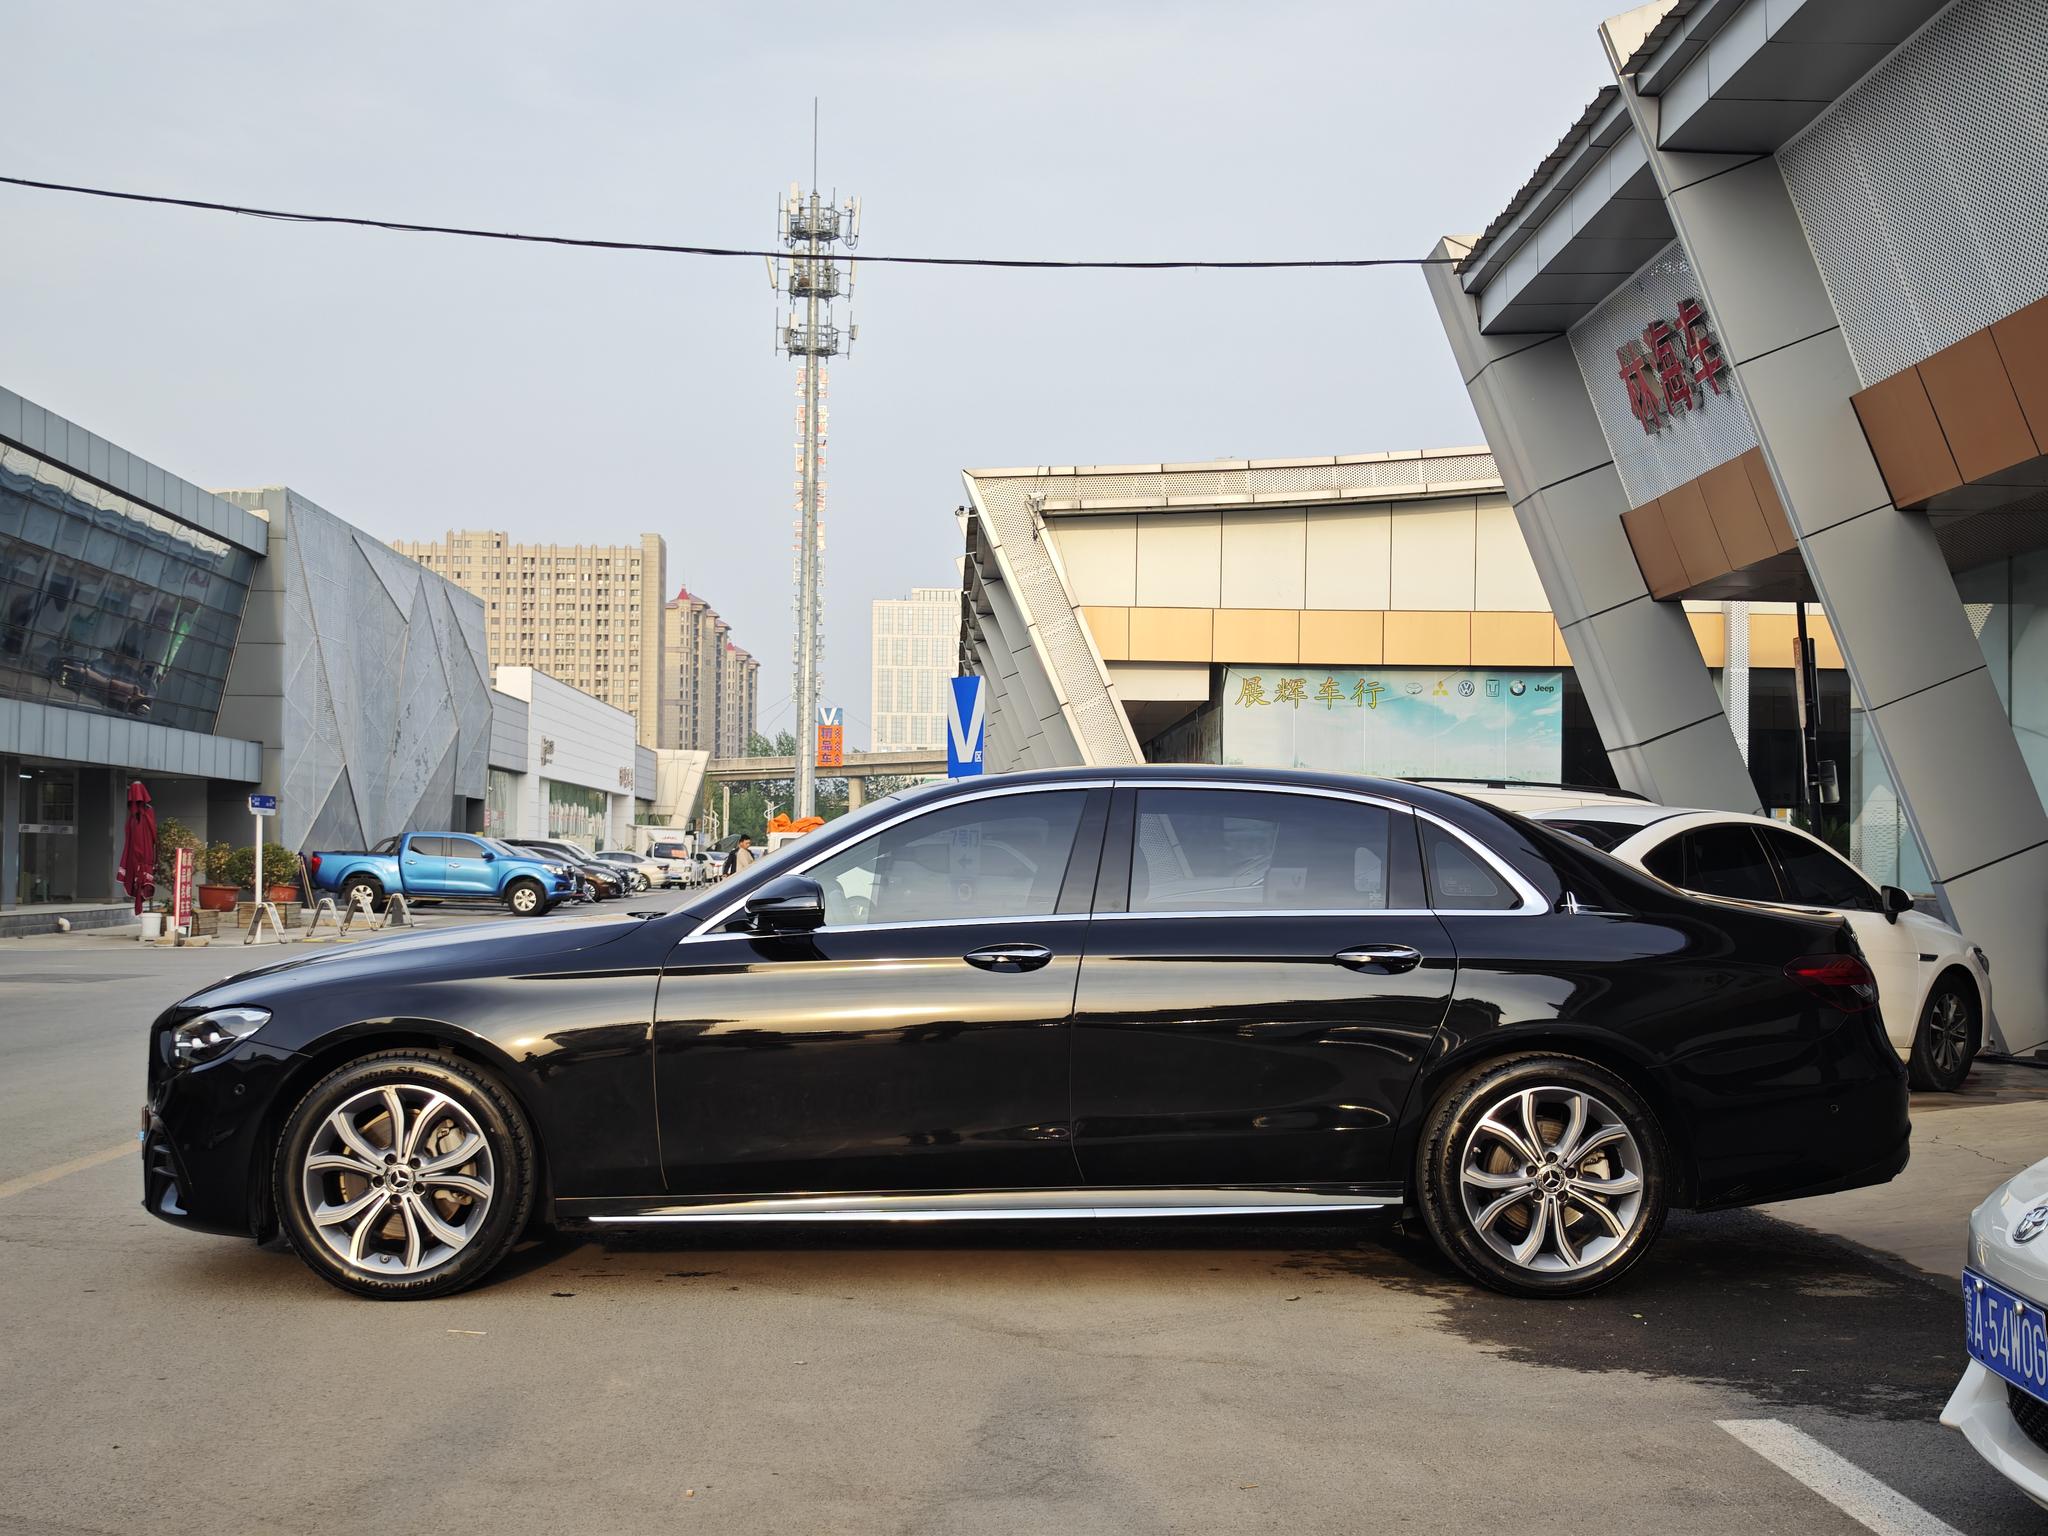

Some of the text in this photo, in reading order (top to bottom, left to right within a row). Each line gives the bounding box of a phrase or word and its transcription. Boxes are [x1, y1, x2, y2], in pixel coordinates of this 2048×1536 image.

[1235, 676, 1385, 711] 展辉车行
[1534, 684, 1555, 694] Jeep
